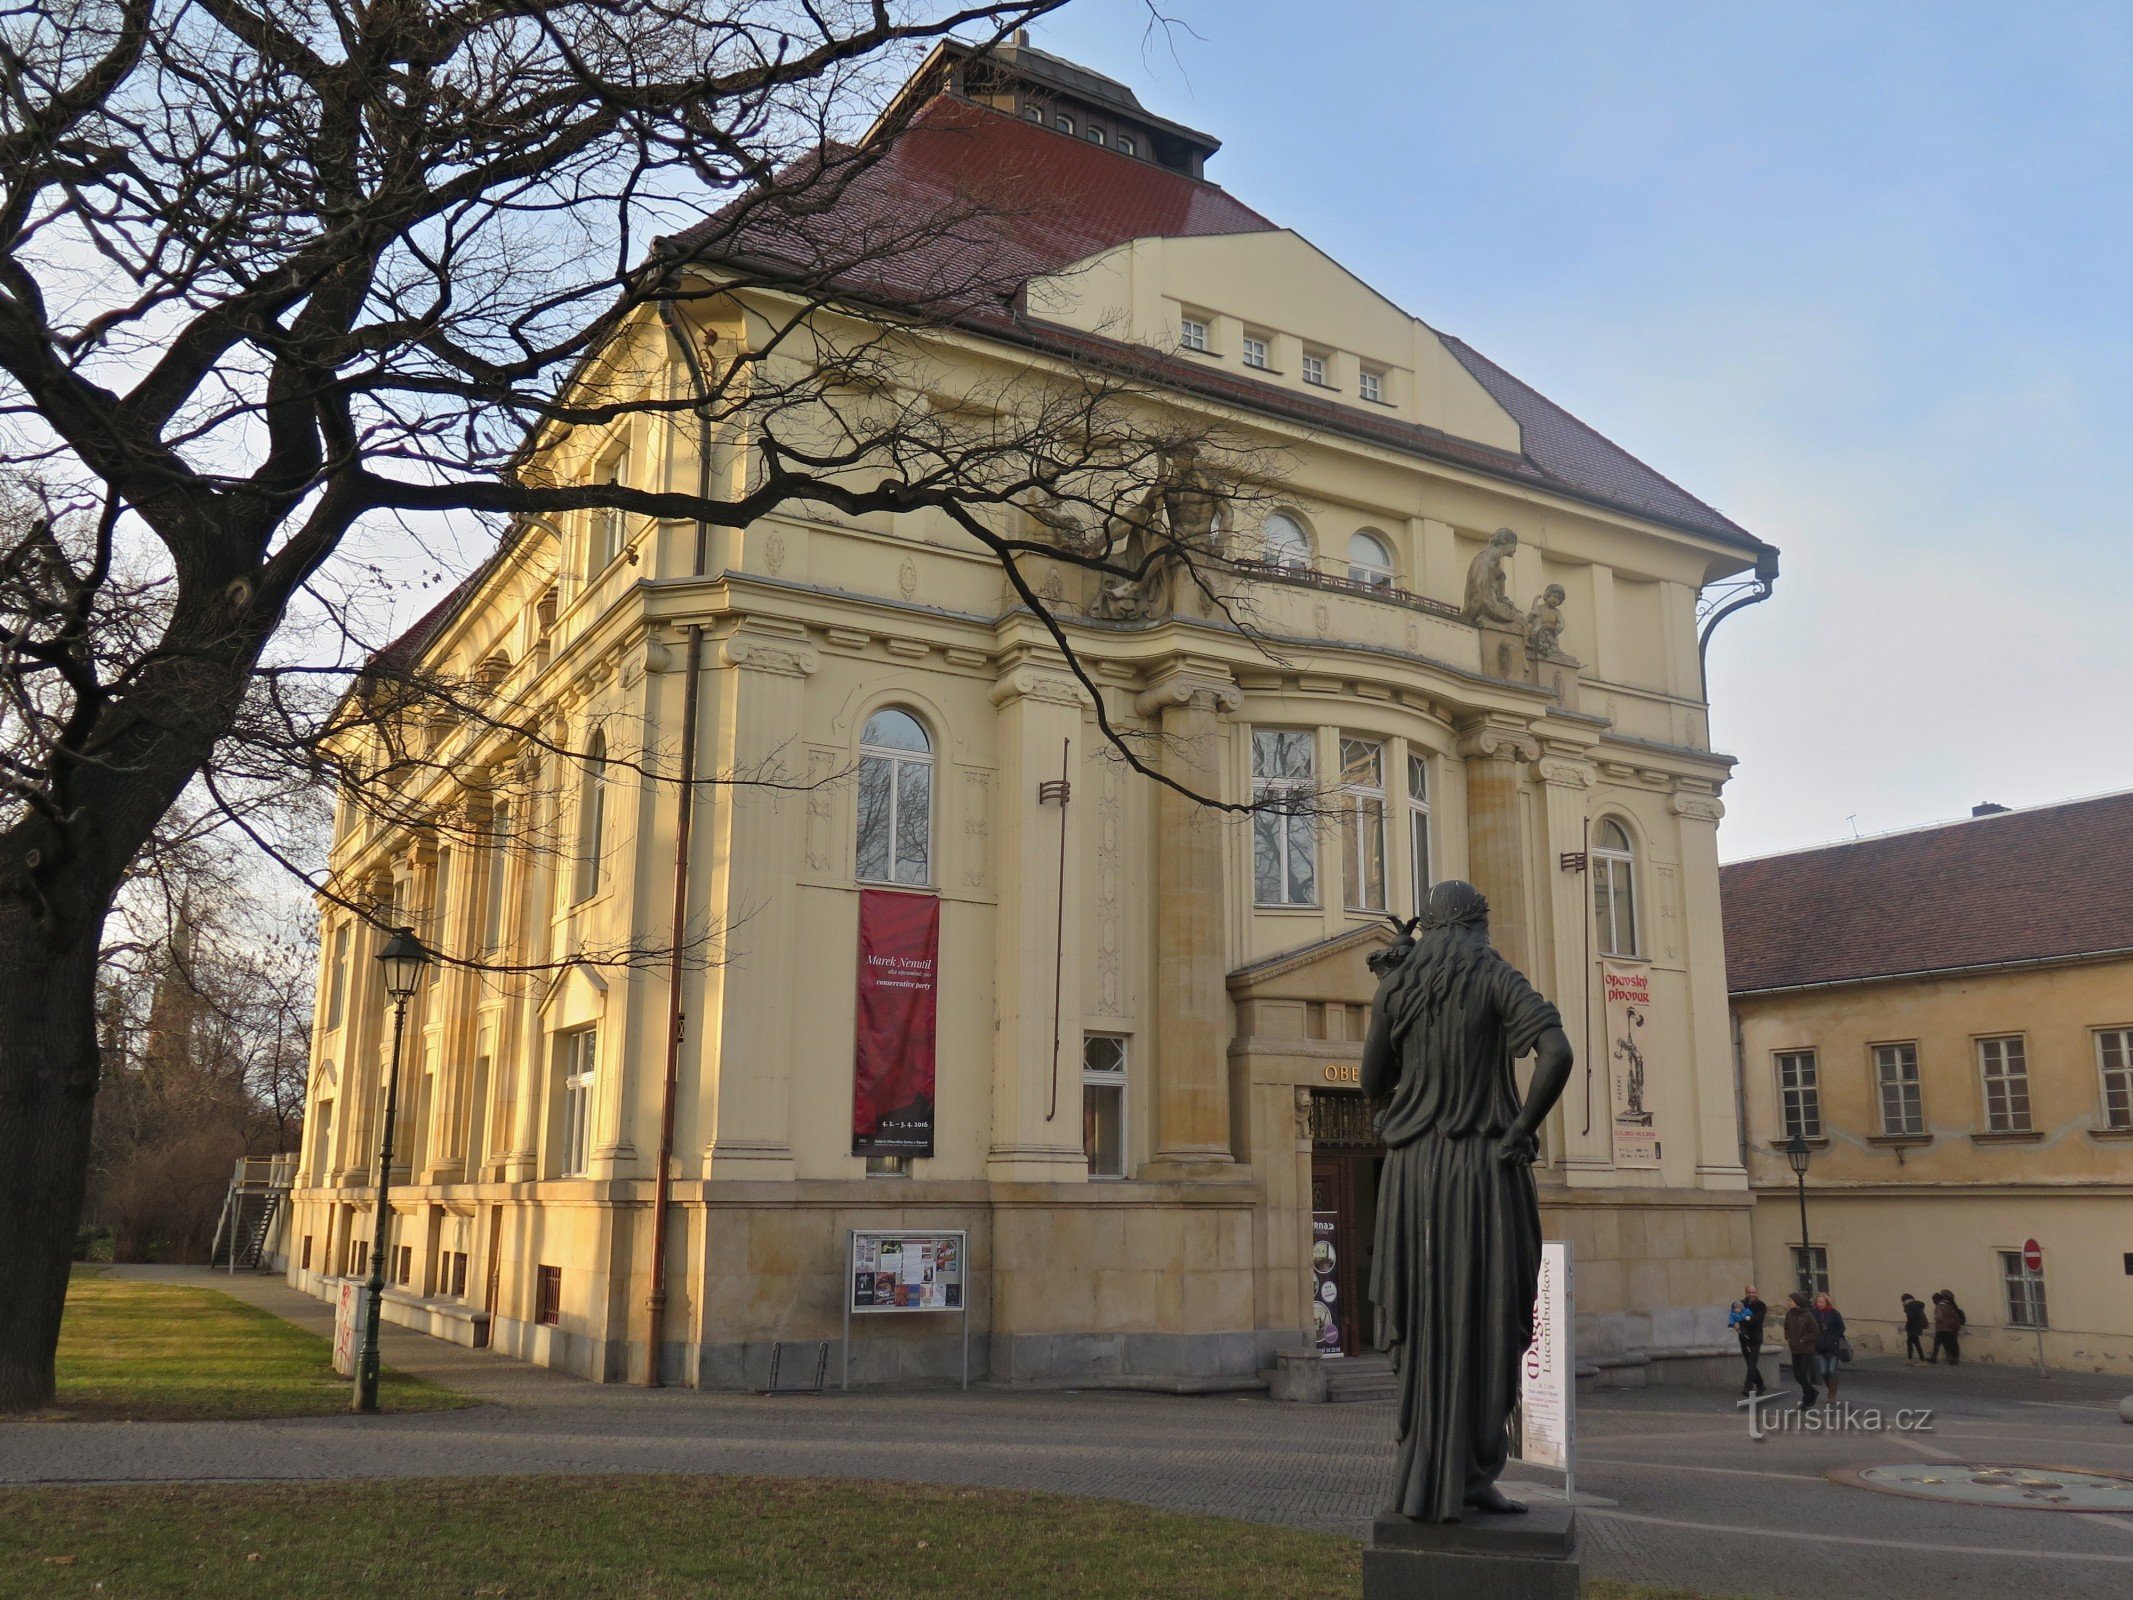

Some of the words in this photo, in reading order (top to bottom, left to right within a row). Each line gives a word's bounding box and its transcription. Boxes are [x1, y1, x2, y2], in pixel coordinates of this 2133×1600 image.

[866, 955, 896, 966] Marek
[897, 958, 931, 969] Nenutil
[915, 982, 931, 990] party
[1605, 974, 1648, 990] opavský
[1324, 1065, 1360, 1082] OBE
